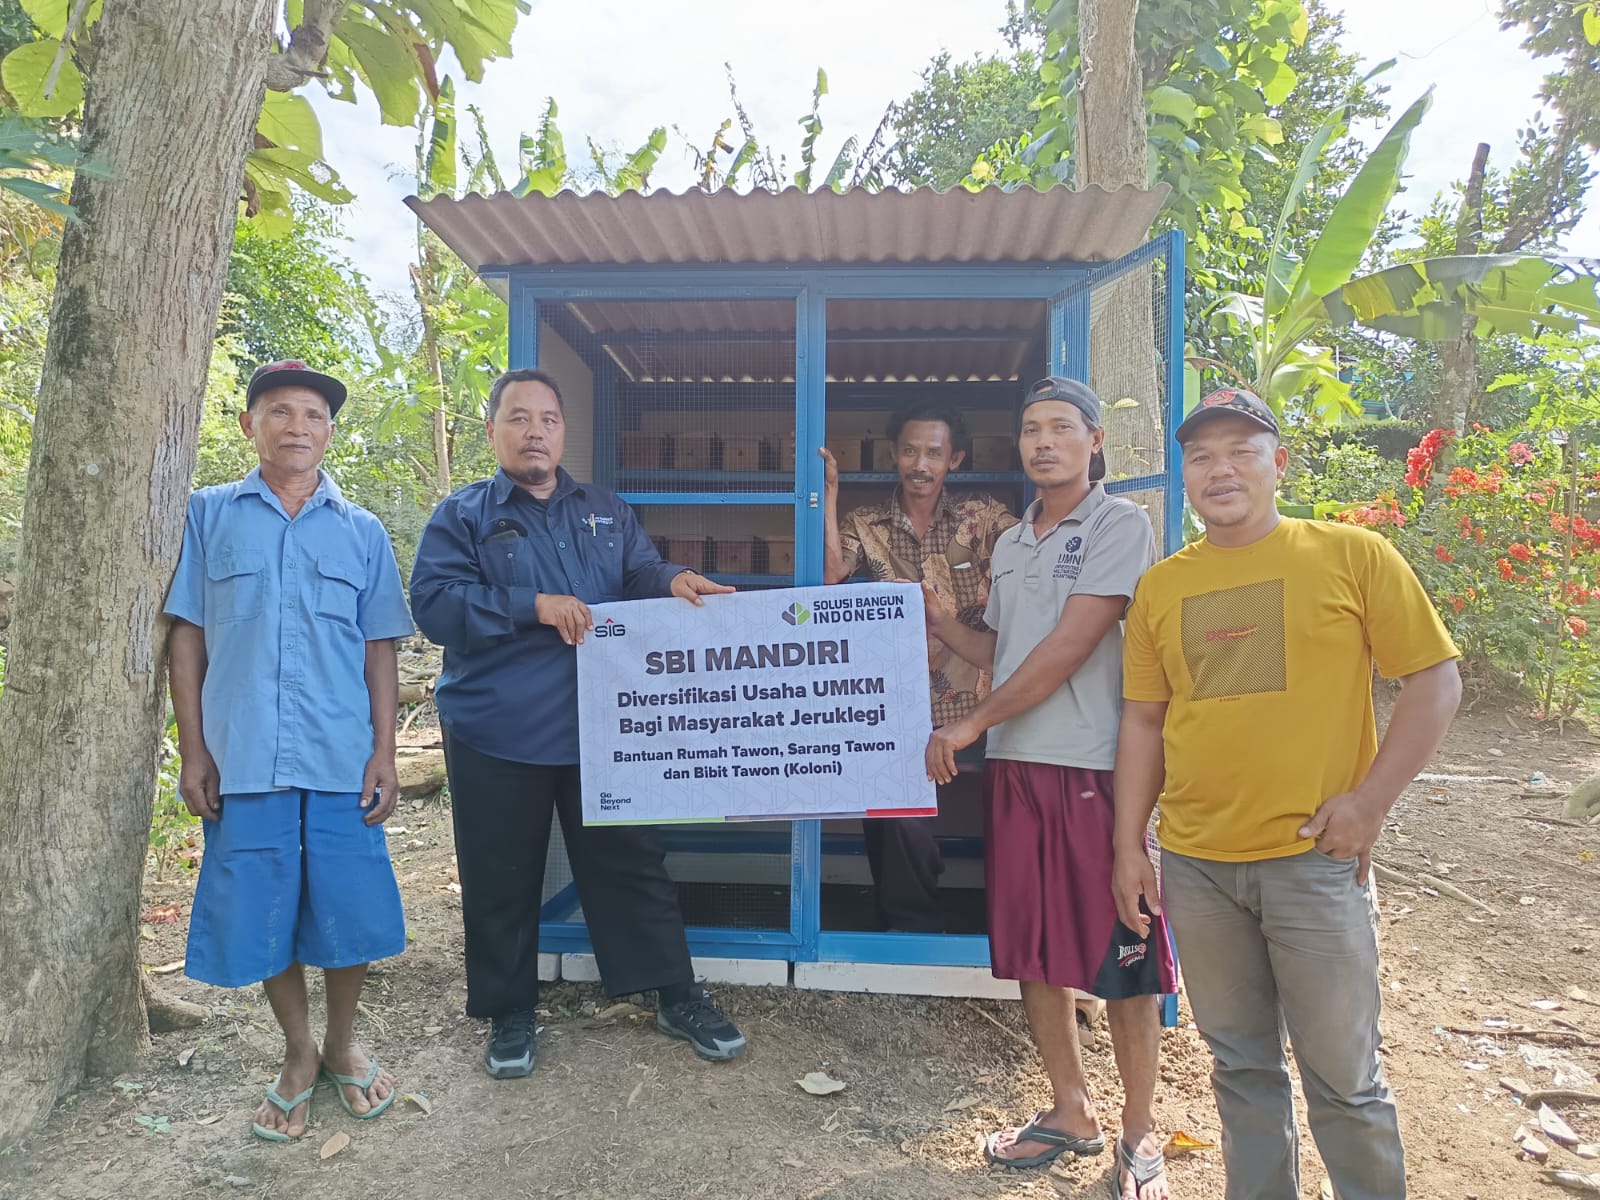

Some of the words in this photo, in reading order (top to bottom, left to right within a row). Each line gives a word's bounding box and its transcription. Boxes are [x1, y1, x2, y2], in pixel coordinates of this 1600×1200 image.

[1057, 553, 1081, 565] UMN
[814, 599, 852, 611] SOLUSI
[856, 595, 903, 609] BANGUN
[814, 607, 904, 624] INDONESIA
[595, 625, 625, 637] SIG
[646, 650, 695, 675] SBI
[705, 639, 849, 671] MANDIRI
[618, 685, 736, 707] Diversifikasi
[743, 683, 806, 700] Usaha
[813, 678, 884, 697] UMKM
[620, 716, 662, 736] Bagi
[668, 712, 784, 734] Masyarakat
[790, 704, 885, 726] Jeruklegi
[614, 751, 672, 762] Bantuan
[677, 747, 727, 759] Rumah
[732, 746, 783, 757] Tawon,
[788, 743, 840, 756] Sarang
[845, 741, 895, 752] Tawon
[664, 768, 689, 779] dan
[694, 766, 728, 778] Bibit
[732, 766, 779, 777] Tawon
[784, 761, 842, 778] (Koloni)
[601, 797, 631, 805] Beyond
